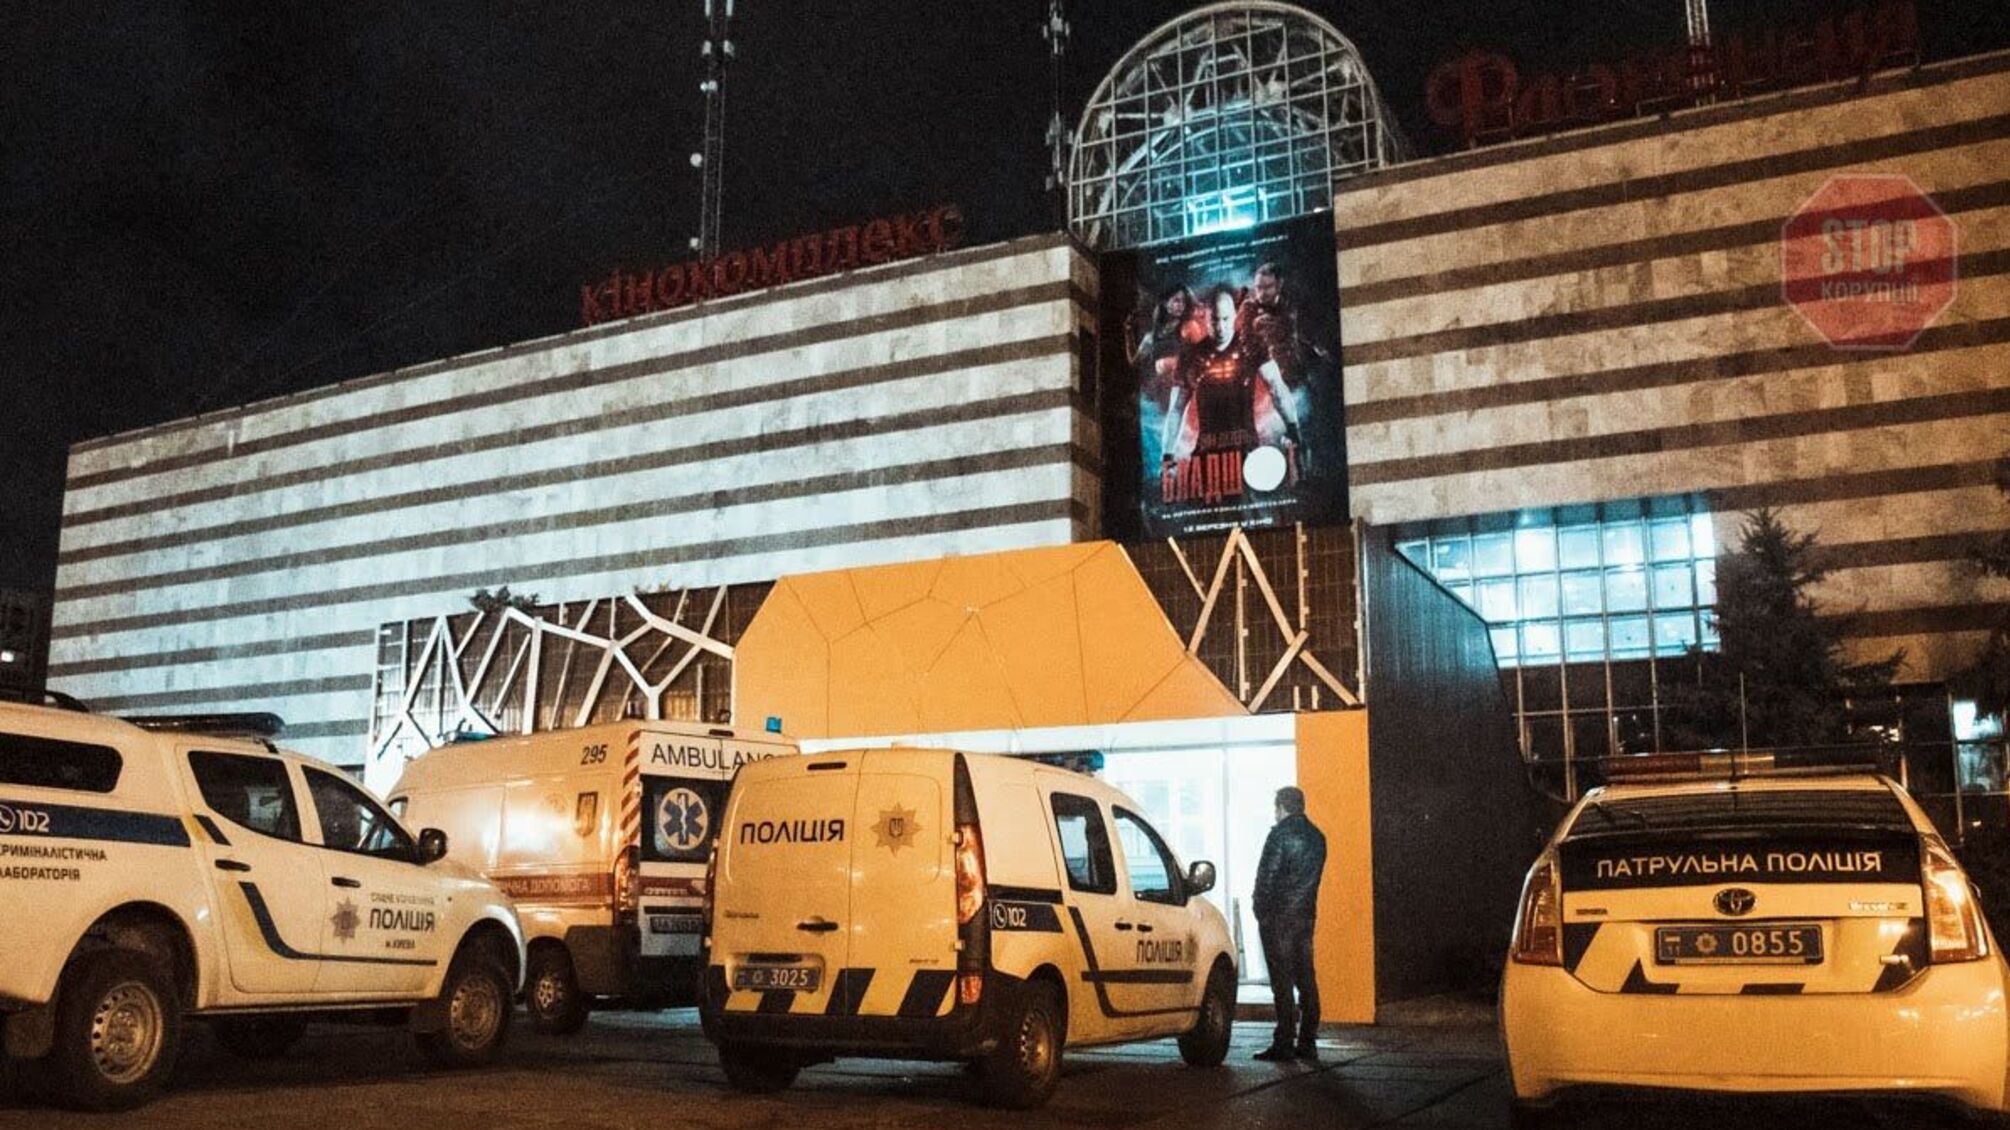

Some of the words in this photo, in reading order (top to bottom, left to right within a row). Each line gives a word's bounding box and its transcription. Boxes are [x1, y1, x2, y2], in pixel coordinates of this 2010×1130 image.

[580, 744, 608, 765] 295
[651, 743, 775, 770] AMBULAN
[15, 809, 50, 833] 102
[740, 819, 844, 844] ПОЛІЦІЯ
[0, 844, 108, 861] РИМІНАЛІСТИЧНА
[1597, 854, 1759, 878] ПАТРУЛЬНА
[1766, 852, 1883, 872] ПОЛІЦІЯ
[369, 908, 435, 932] ПОЛІЦІЯ
[1008, 907, 1027, 927] 102
[1136, 940, 1183, 963] ПОЛІЦІЯ
[1731, 931, 1804, 955] 0855
[770, 968, 809, 986] 3025
